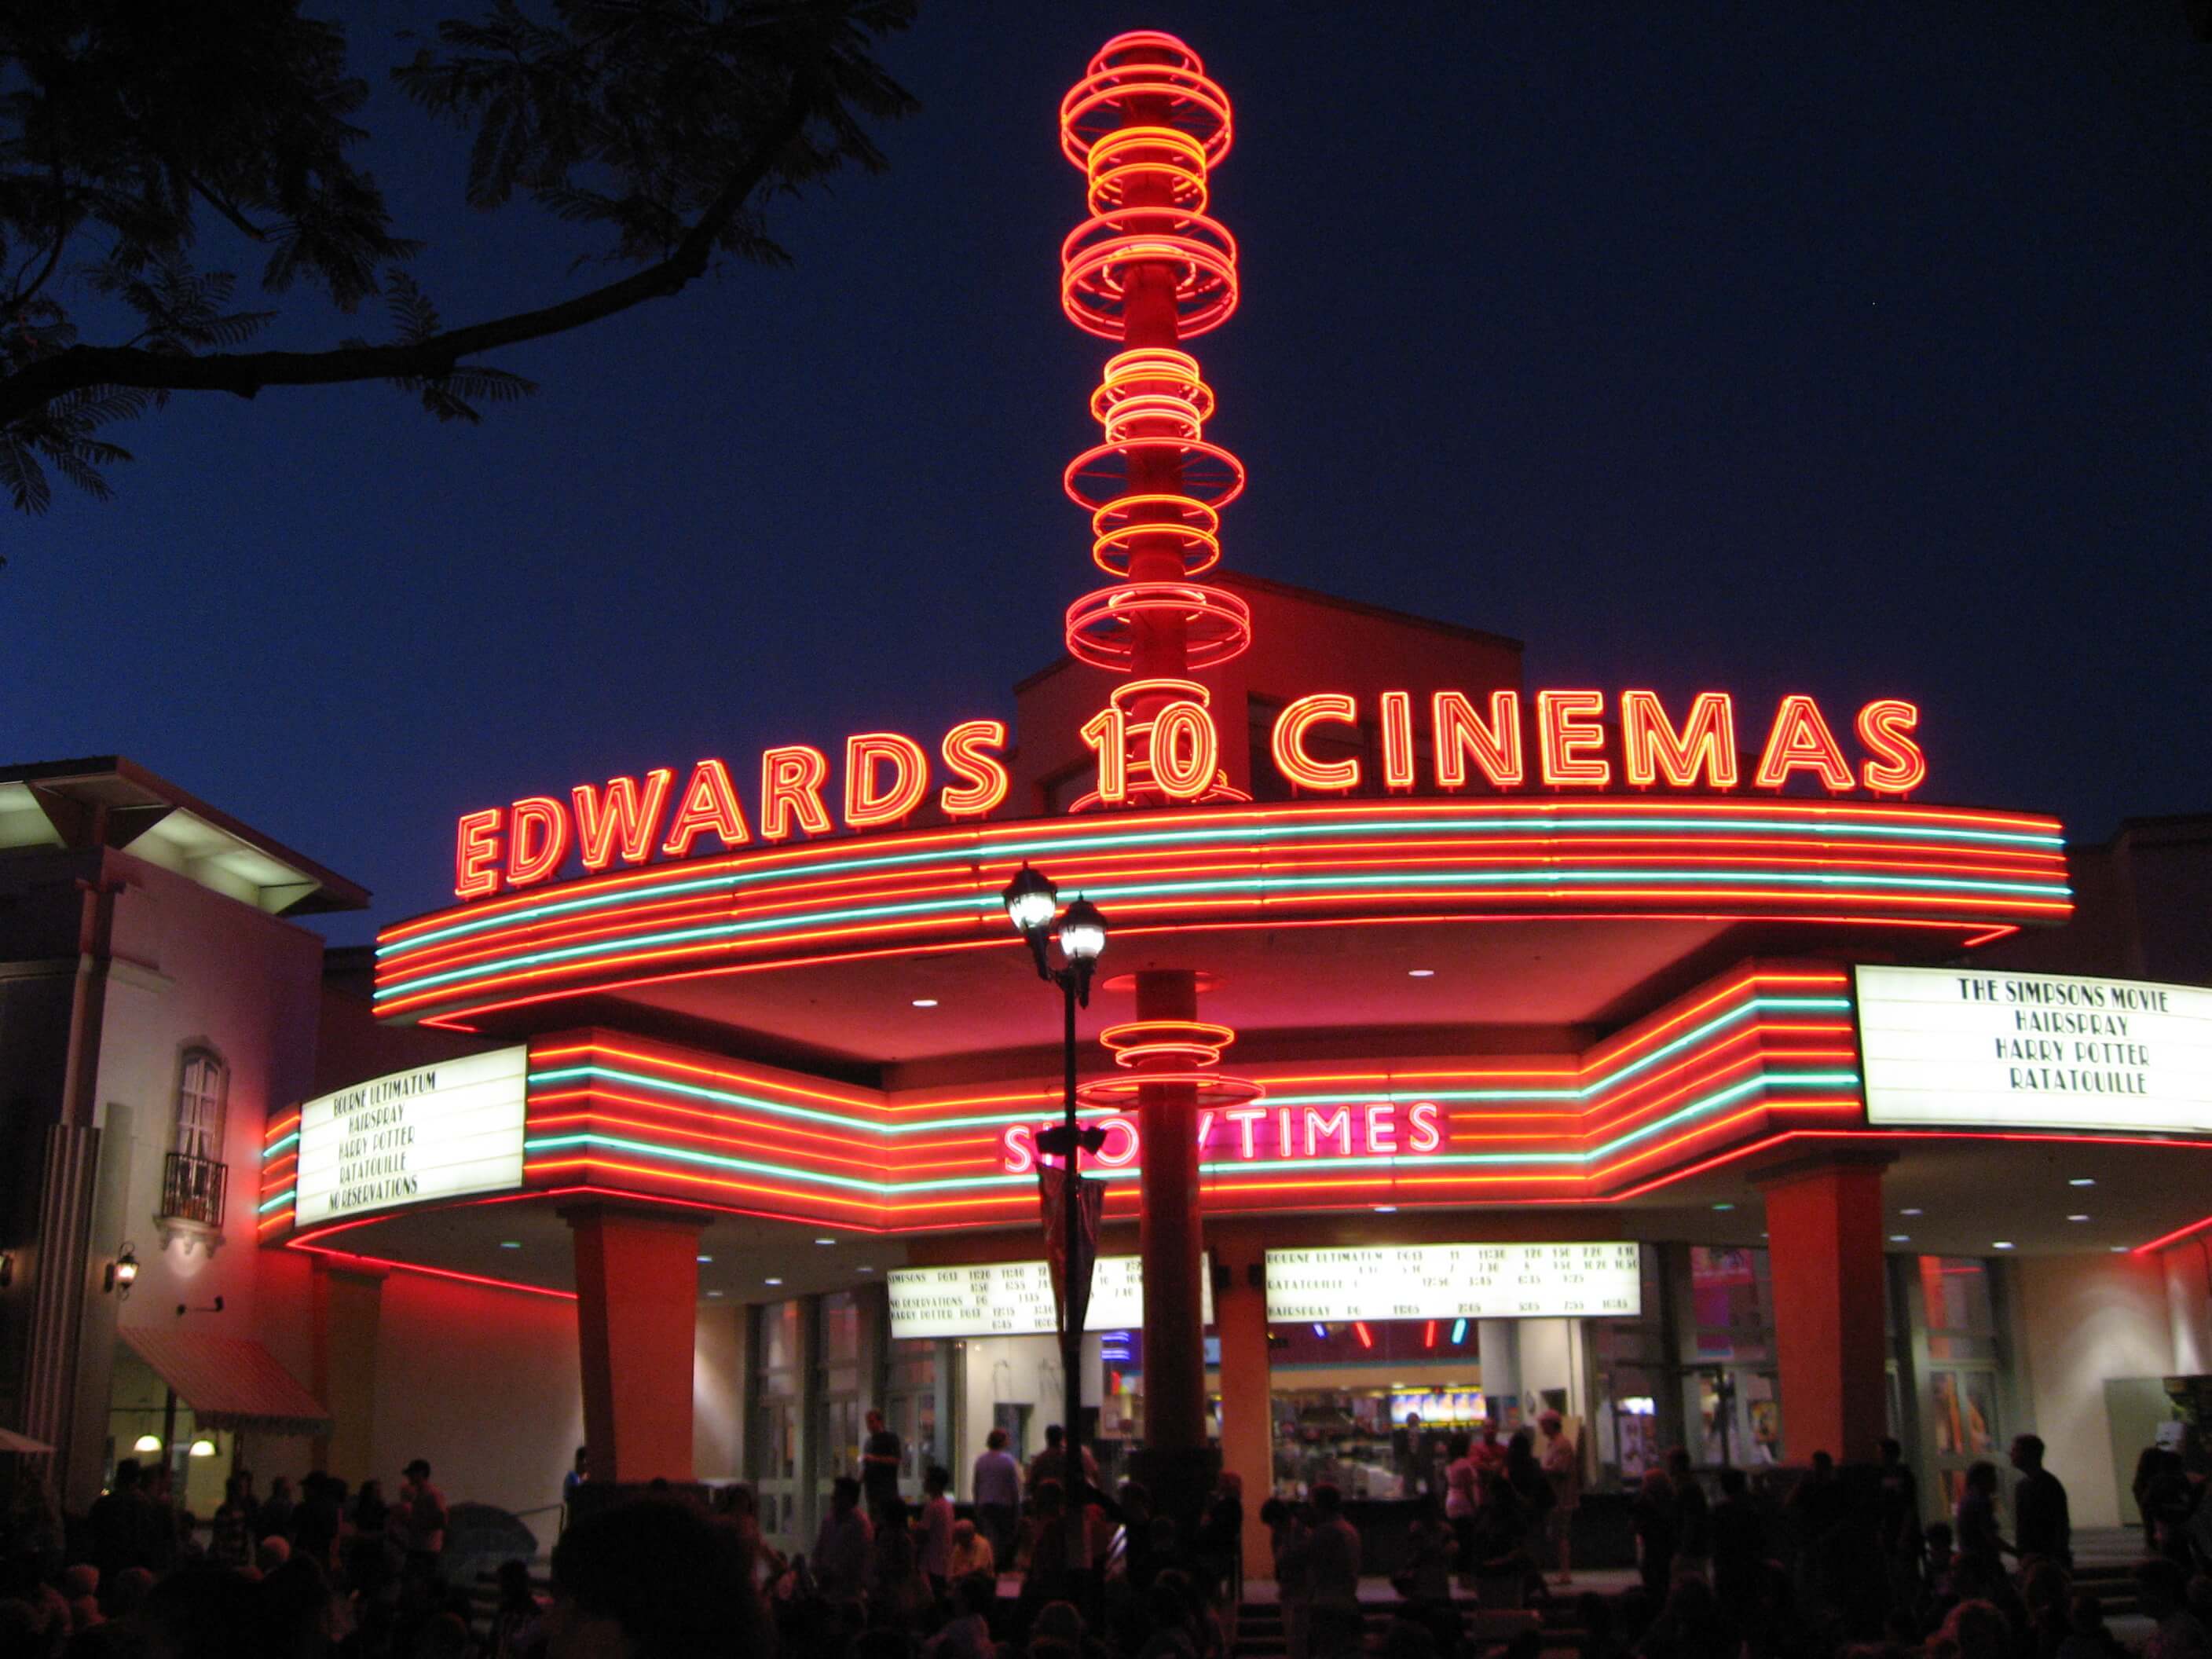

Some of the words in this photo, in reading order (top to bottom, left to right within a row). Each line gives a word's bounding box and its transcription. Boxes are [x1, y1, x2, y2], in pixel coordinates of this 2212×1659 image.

[456, 720, 1009, 897] EDWARDS
[1081, 702, 1218, 800] 10
[1273, 690, 1925, 793] CINEMAS
[1957, 978, 1998, 1002] THE
[2005, 980, 2106, 1008] SIMPSONS
[2111, 987, 2170, 1013] MOVIE
[2016, 1009, 2128, 1036] HAIRSPRAY
[1995, 1038, 2064, 1062] HARRY
[2075, 1041, 2150, 1066] POTTER
[333, 1086, 367, 1116] BOURNE
[370, 1071, 436, 1104] ULTIMATUM
[2009, 1067, 2148, 1093] RATATOUILLE
[348, 1104, 405, 1133] HAIRSPRAY
[339, 1134, 368, 1161] HARRY
[373, 1125, 416, 1149] POTTER
[1005, 1103, 1441, 1172] SOTIMES
[339, 1152, 407, 1185] RATATOUILLE
[328, 1192, 340, 1213] NO
[341, 1174, 419, 1210] RESERVATIONS
[1317, 1251, 1383, 1262] ULTIMATUM
